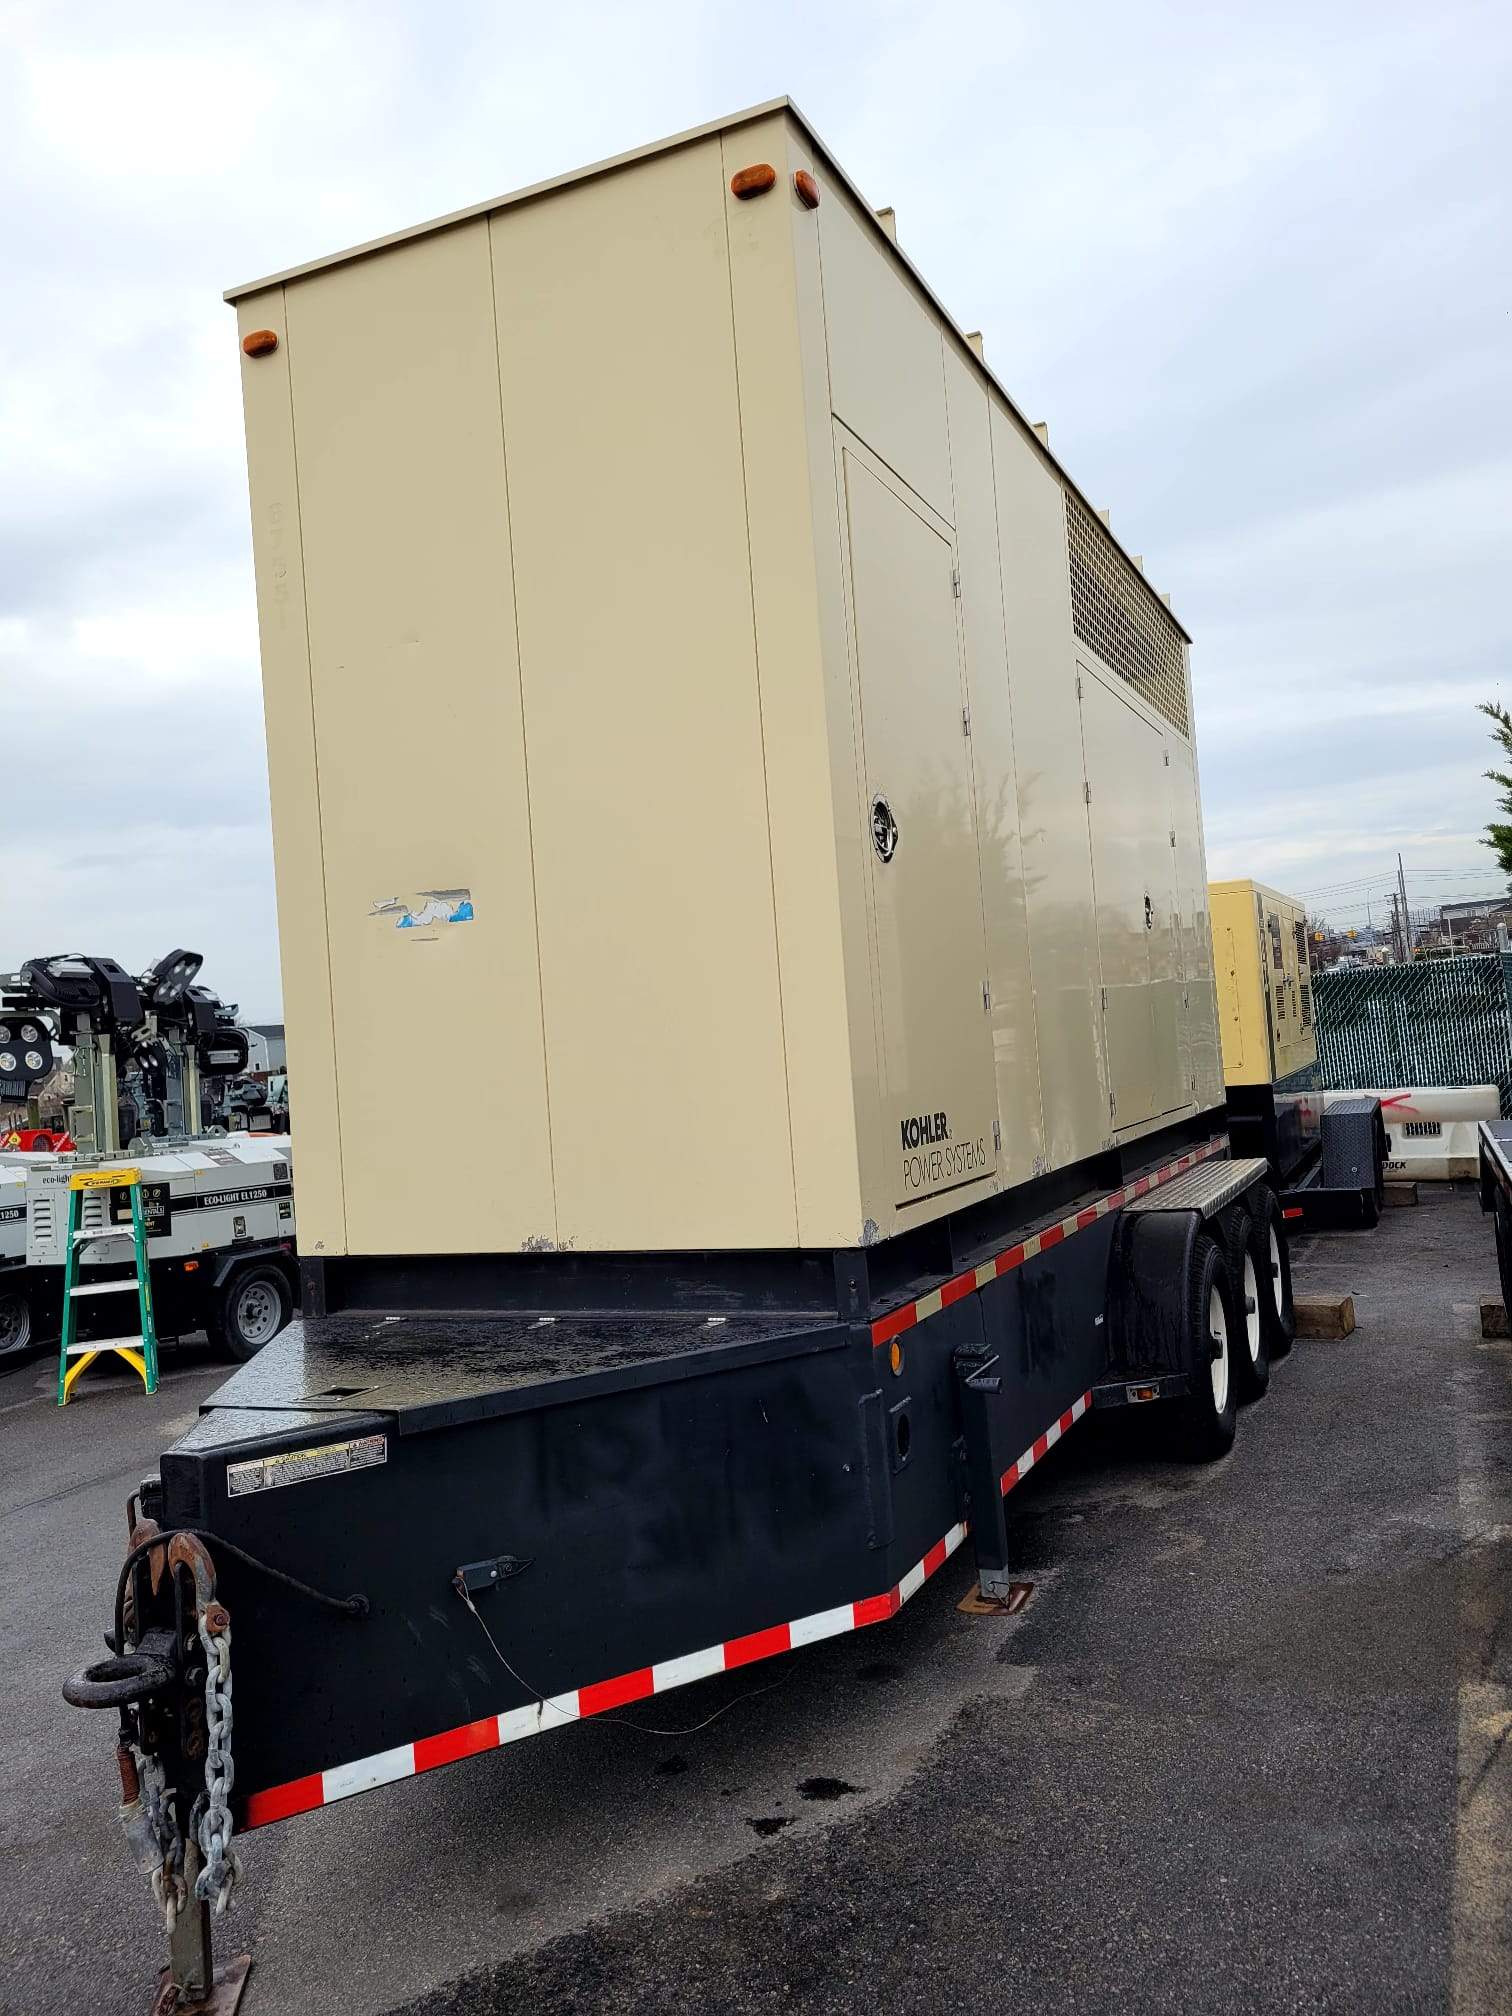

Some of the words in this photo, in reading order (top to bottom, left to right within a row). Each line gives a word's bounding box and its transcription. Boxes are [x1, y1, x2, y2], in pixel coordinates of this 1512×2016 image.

[901, 1112, 948, 1150] KOHLER
[904, 1150, 945, 1190] POWER
[945, 1138, 986, 1176] SYSTEMS
[204, 1192, 240, 1206] ECO-LIGHT
[241, 1189, 267, 1201] EL1250
[0, 1210, 19, 1220] 1250
